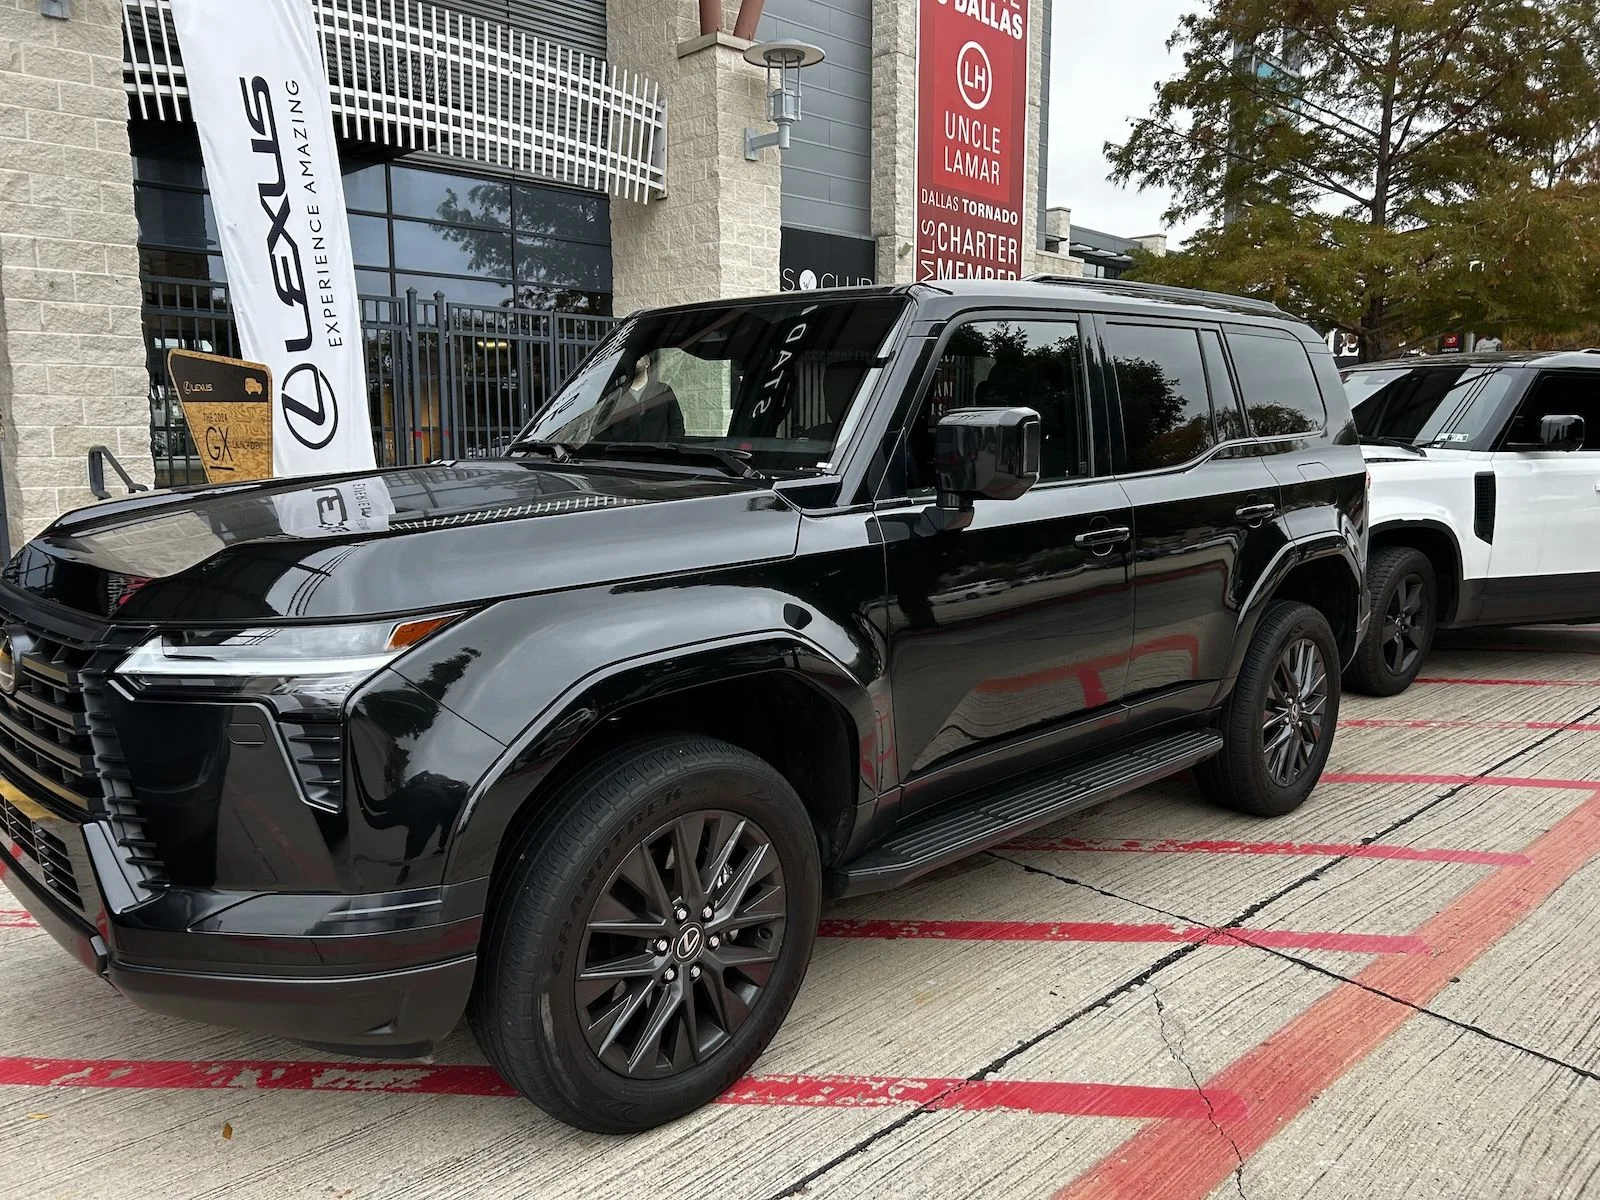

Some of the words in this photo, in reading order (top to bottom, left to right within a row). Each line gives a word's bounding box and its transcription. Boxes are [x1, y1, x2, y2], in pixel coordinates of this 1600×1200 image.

[964, 60, 986, 92] LH
[285, 79, 317, 194] AMAZING
[945, 110, 1001, 155] UNCLE
[944, 145, 1000, 186] LAMAR
[239, 76, 313, 353] LEXUS
[921, 188, 959, 212] DALLAS
[962, 198, 1018, 226] TORNADO
[920, 219, 935, 282] MLS
[937, 222, 1018, 265] CHARTER
[306, 205, 343, 347] EXPERIENCE
[191, 383, 213, 392] LEXUS
[202, 412, 213, 422] THE
[205, 426, 234, 462] GX
